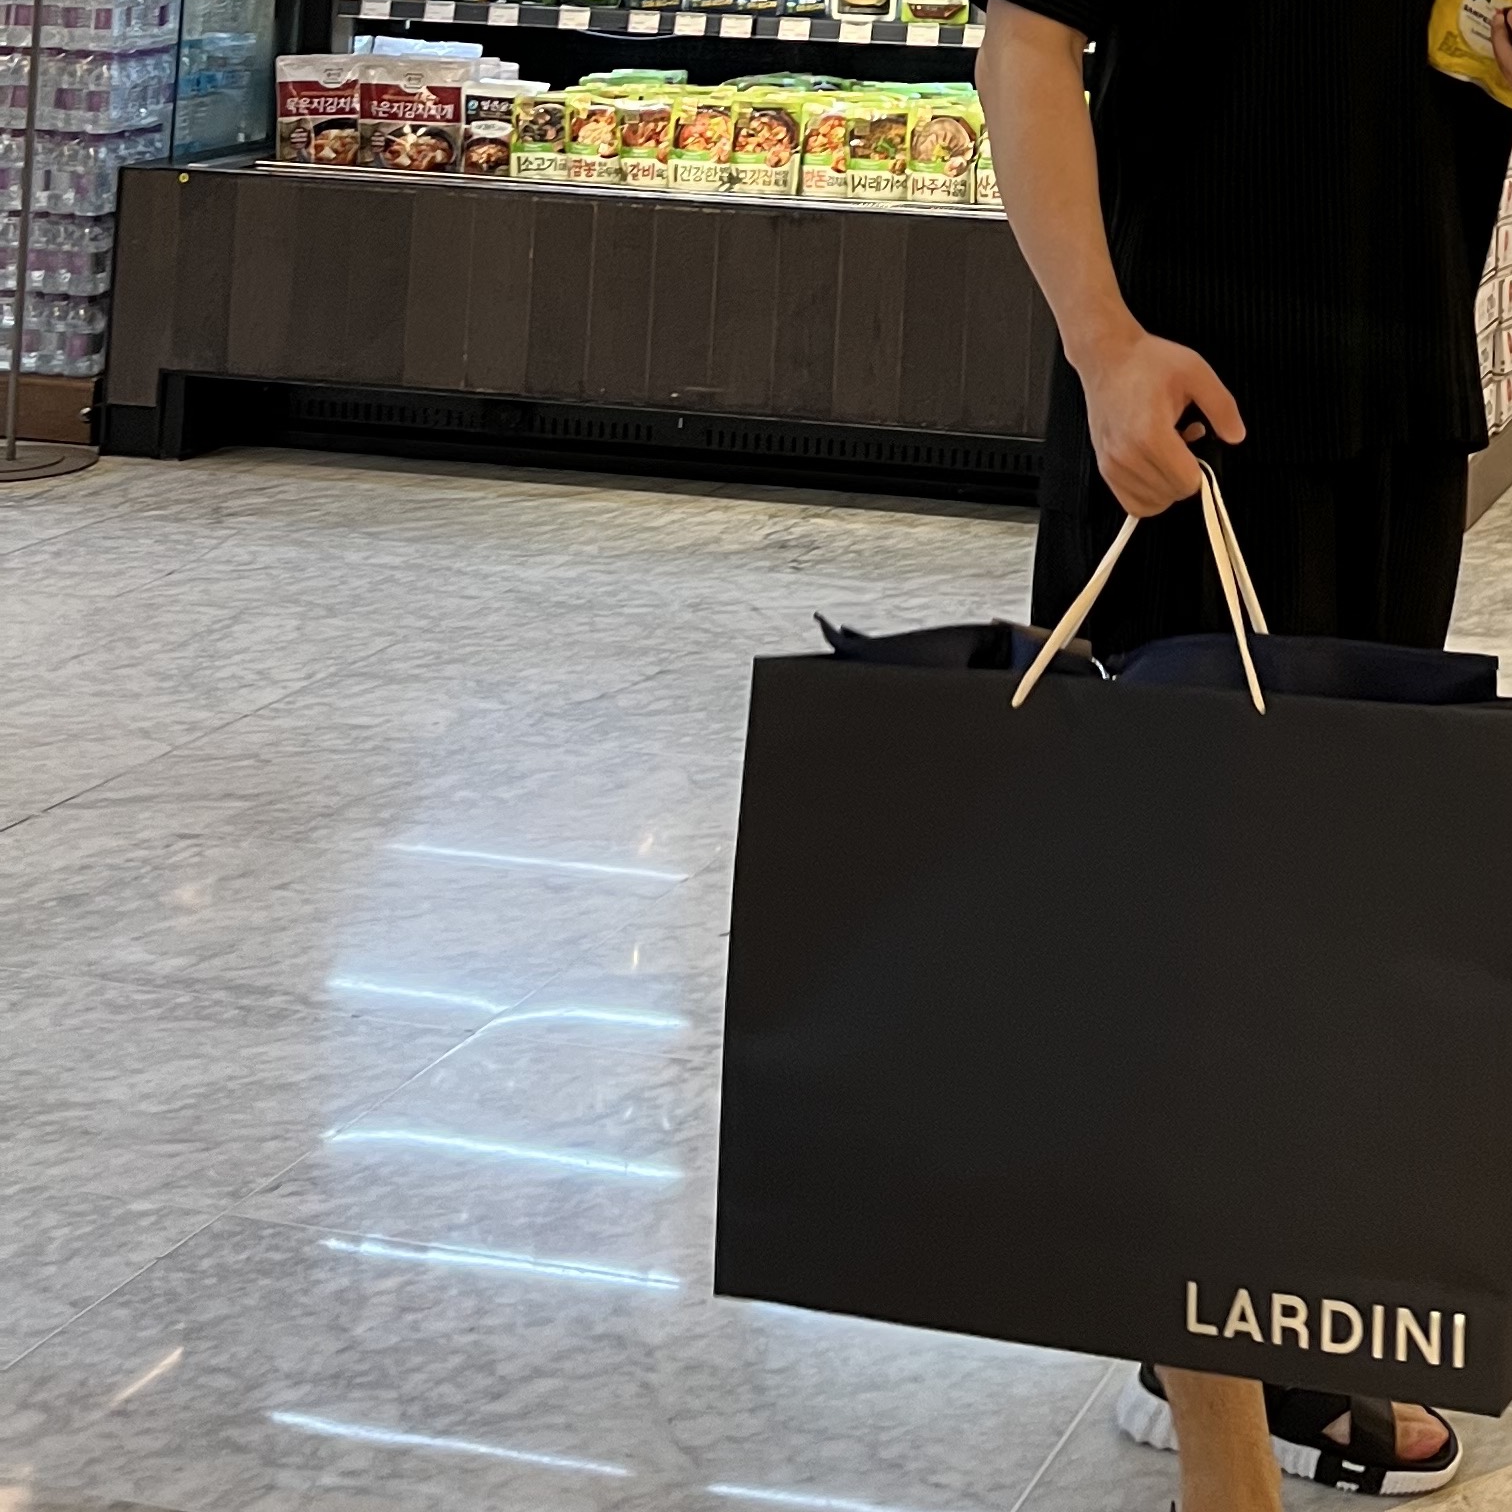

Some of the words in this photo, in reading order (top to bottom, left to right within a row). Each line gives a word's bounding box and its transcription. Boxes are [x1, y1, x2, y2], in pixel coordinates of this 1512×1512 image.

[629, 164, 655, 181] 갈비
[679, 165, 719, 184] 건강한
[856, 175, 895, 194] 시래기
[1186, 1280, 1467, 1369] LARDINI
